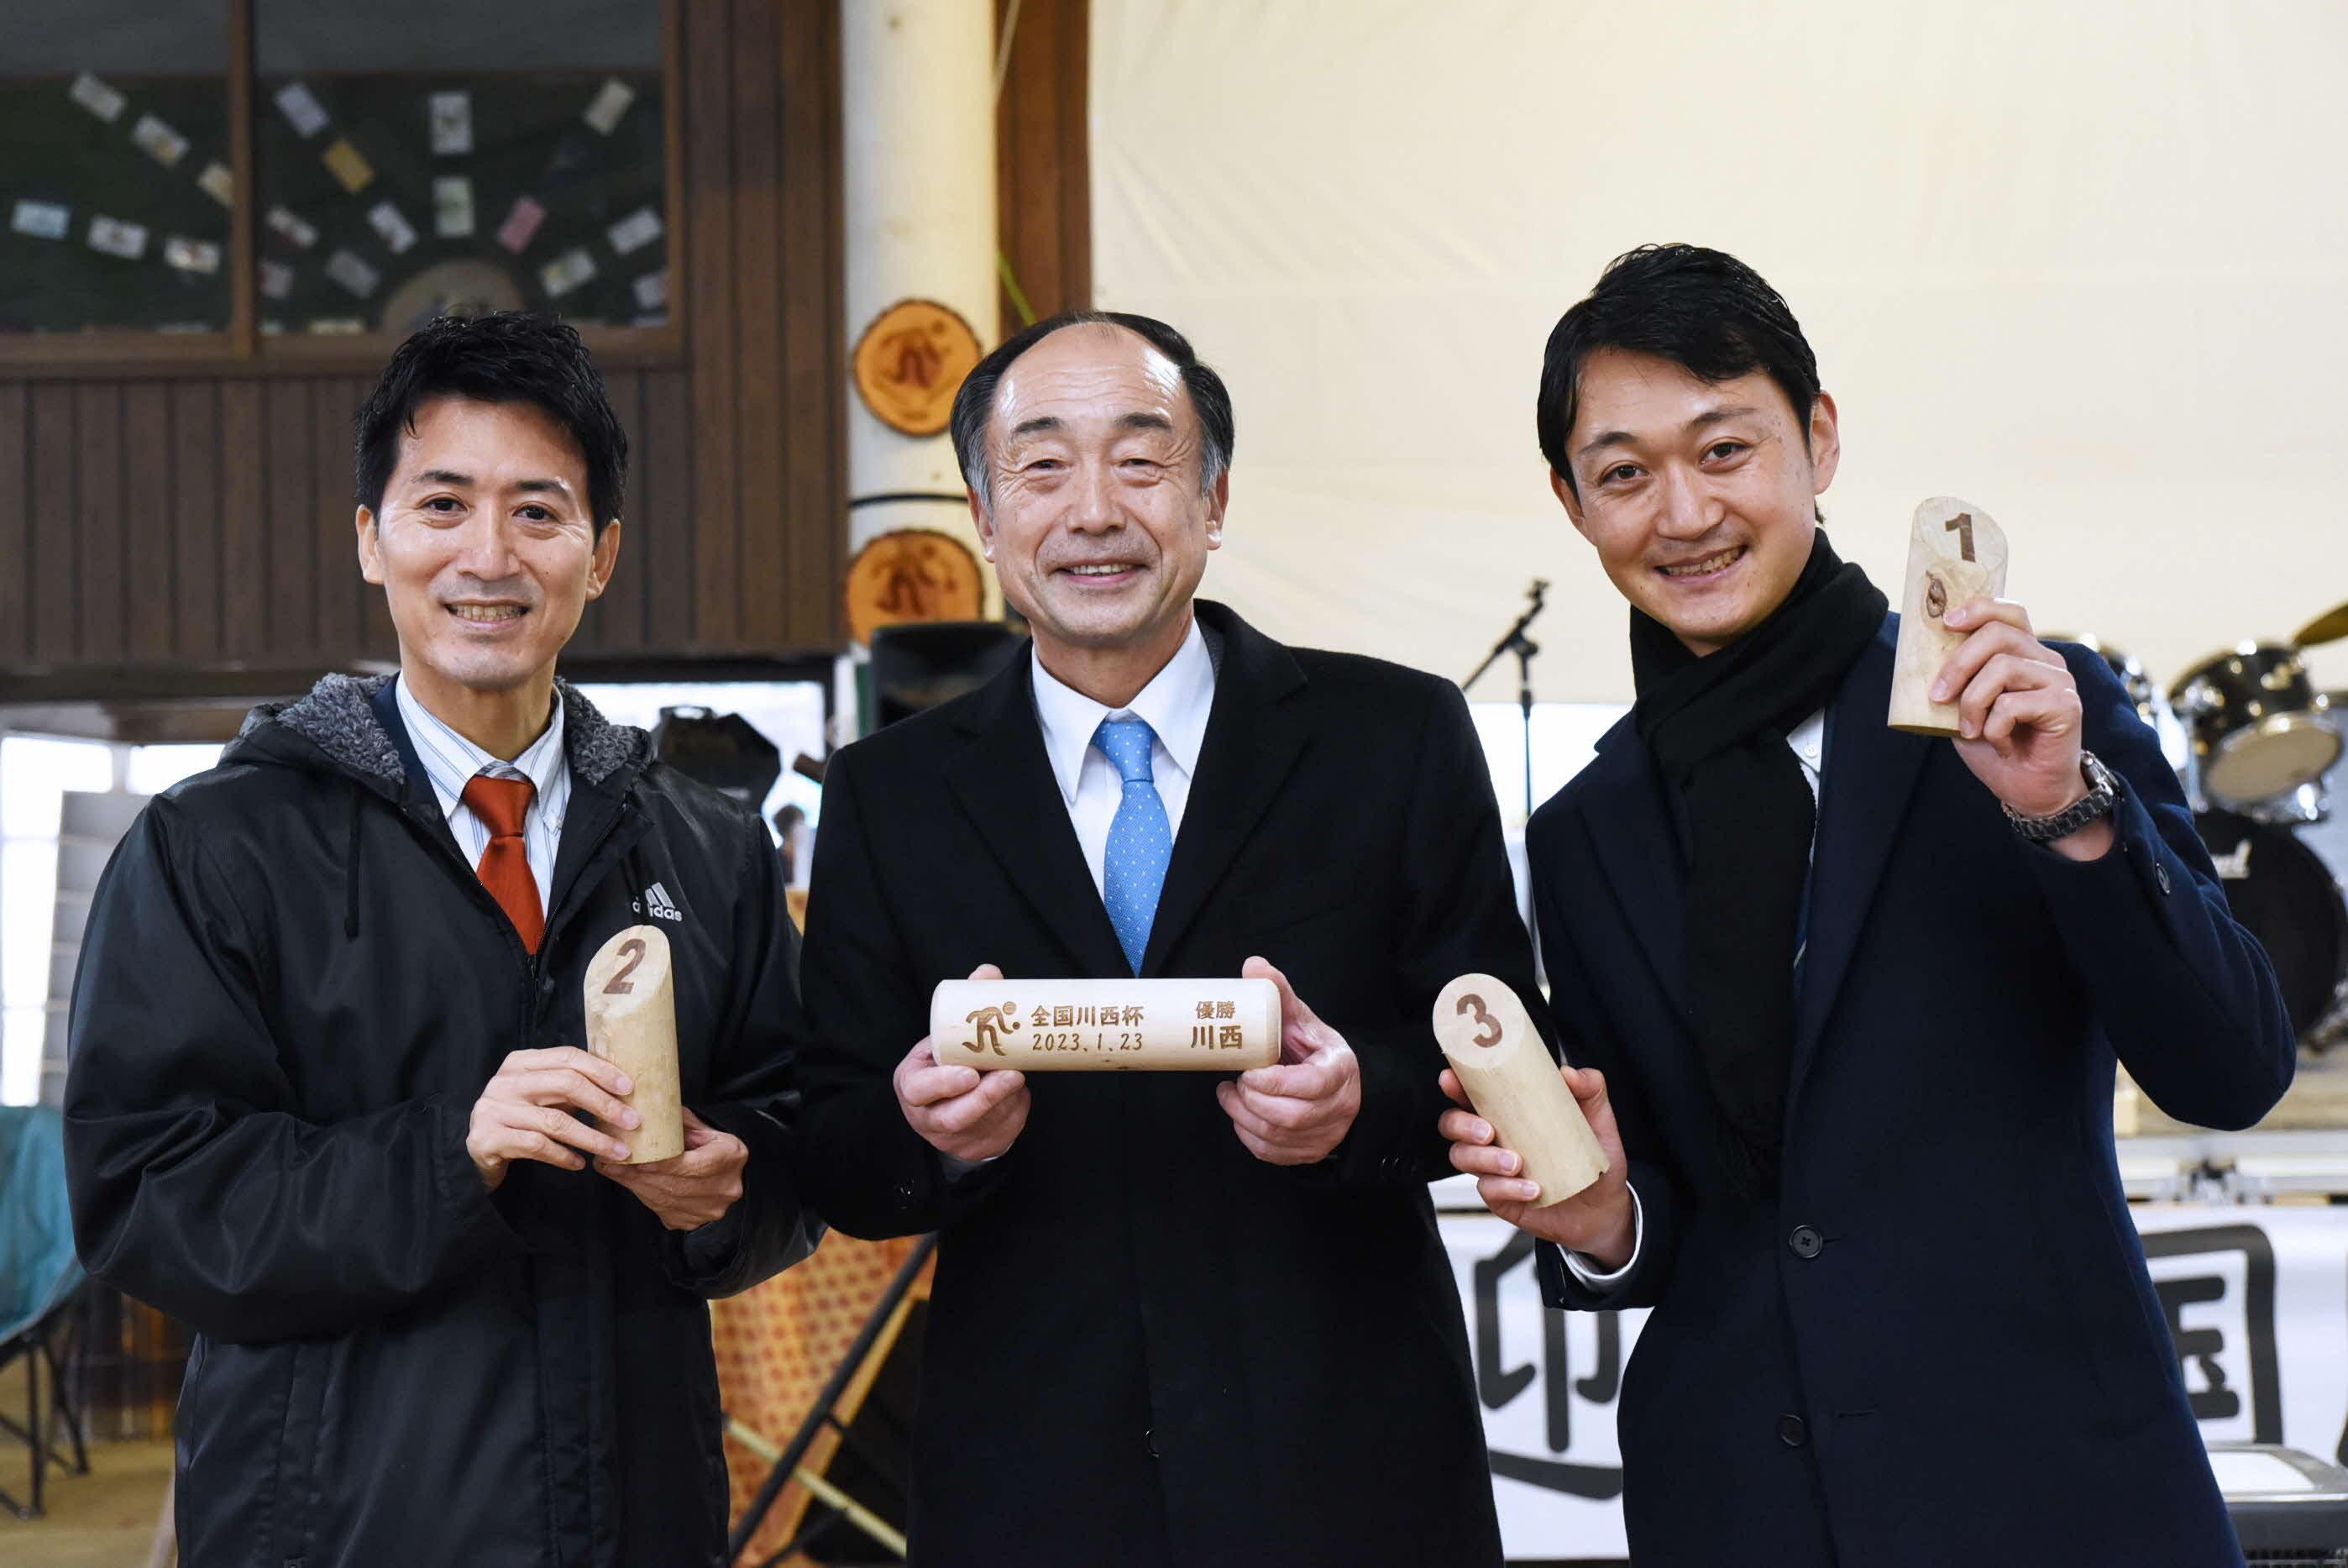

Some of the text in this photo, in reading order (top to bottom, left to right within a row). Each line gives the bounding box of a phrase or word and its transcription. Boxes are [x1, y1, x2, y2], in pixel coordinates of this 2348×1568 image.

[1945, 512, 1975, 563] 1
[602, 938, 646, 994] 2
[1031, 1004, 1145, 1027] 全国川西杯
[1196, 1001, 1235, 1020] 優勝
[1456, 994, 1502, 1048] 3
